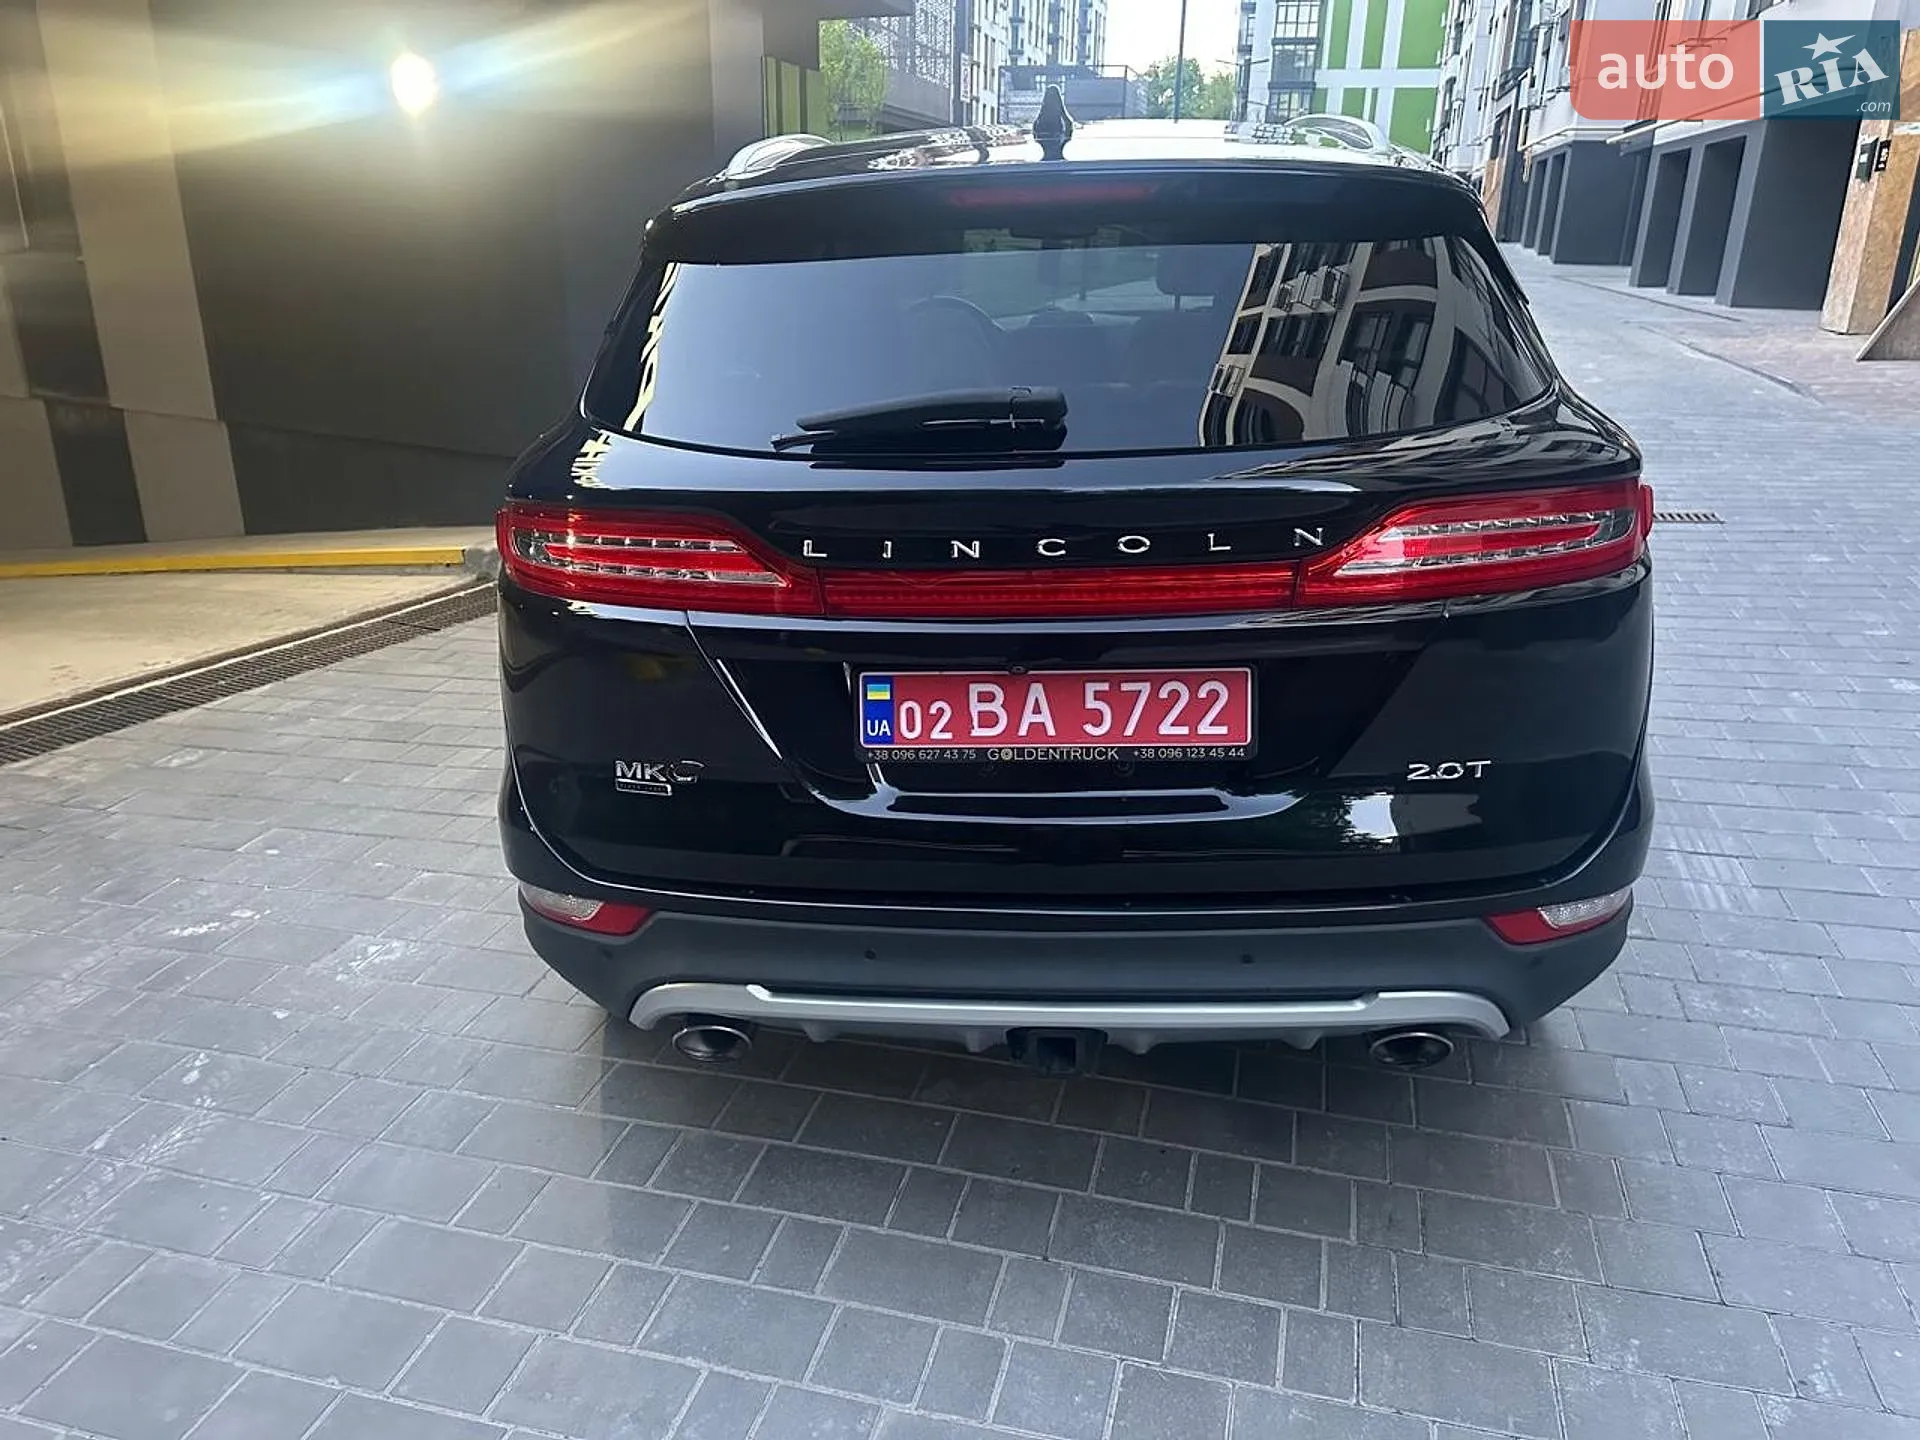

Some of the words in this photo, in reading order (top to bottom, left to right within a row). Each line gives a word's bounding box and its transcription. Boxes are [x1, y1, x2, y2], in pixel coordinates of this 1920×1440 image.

[803, 526, 1324, 559] LINCOLN
[898, 700, 953, 740] 02
[968, 681, 1057, 737] BA
[1082, 679, 1230, 737] 5722
[866, 719, 892, 737] UA
[868, 750, 889, 761] +38
[892, 750, 916, 760] 096
[918, 749, 941, 760] 627
[943, 749, 959, 760] 43
[961, 749, 977, 760] 75
[986, 747, 1120, 761] GOLDENTRUCK
[1133, 748, 1155, 759] +38
[1158, 748, 1183, 759] 096
[1186, 748, 1206, 758] 123
[1209, 748, 1225, 758] 45
[1228, 747, 1245, 758] 44
[615, 760, 705, 783] MKC
[1406, 760, 1492, 781] 2.0T
